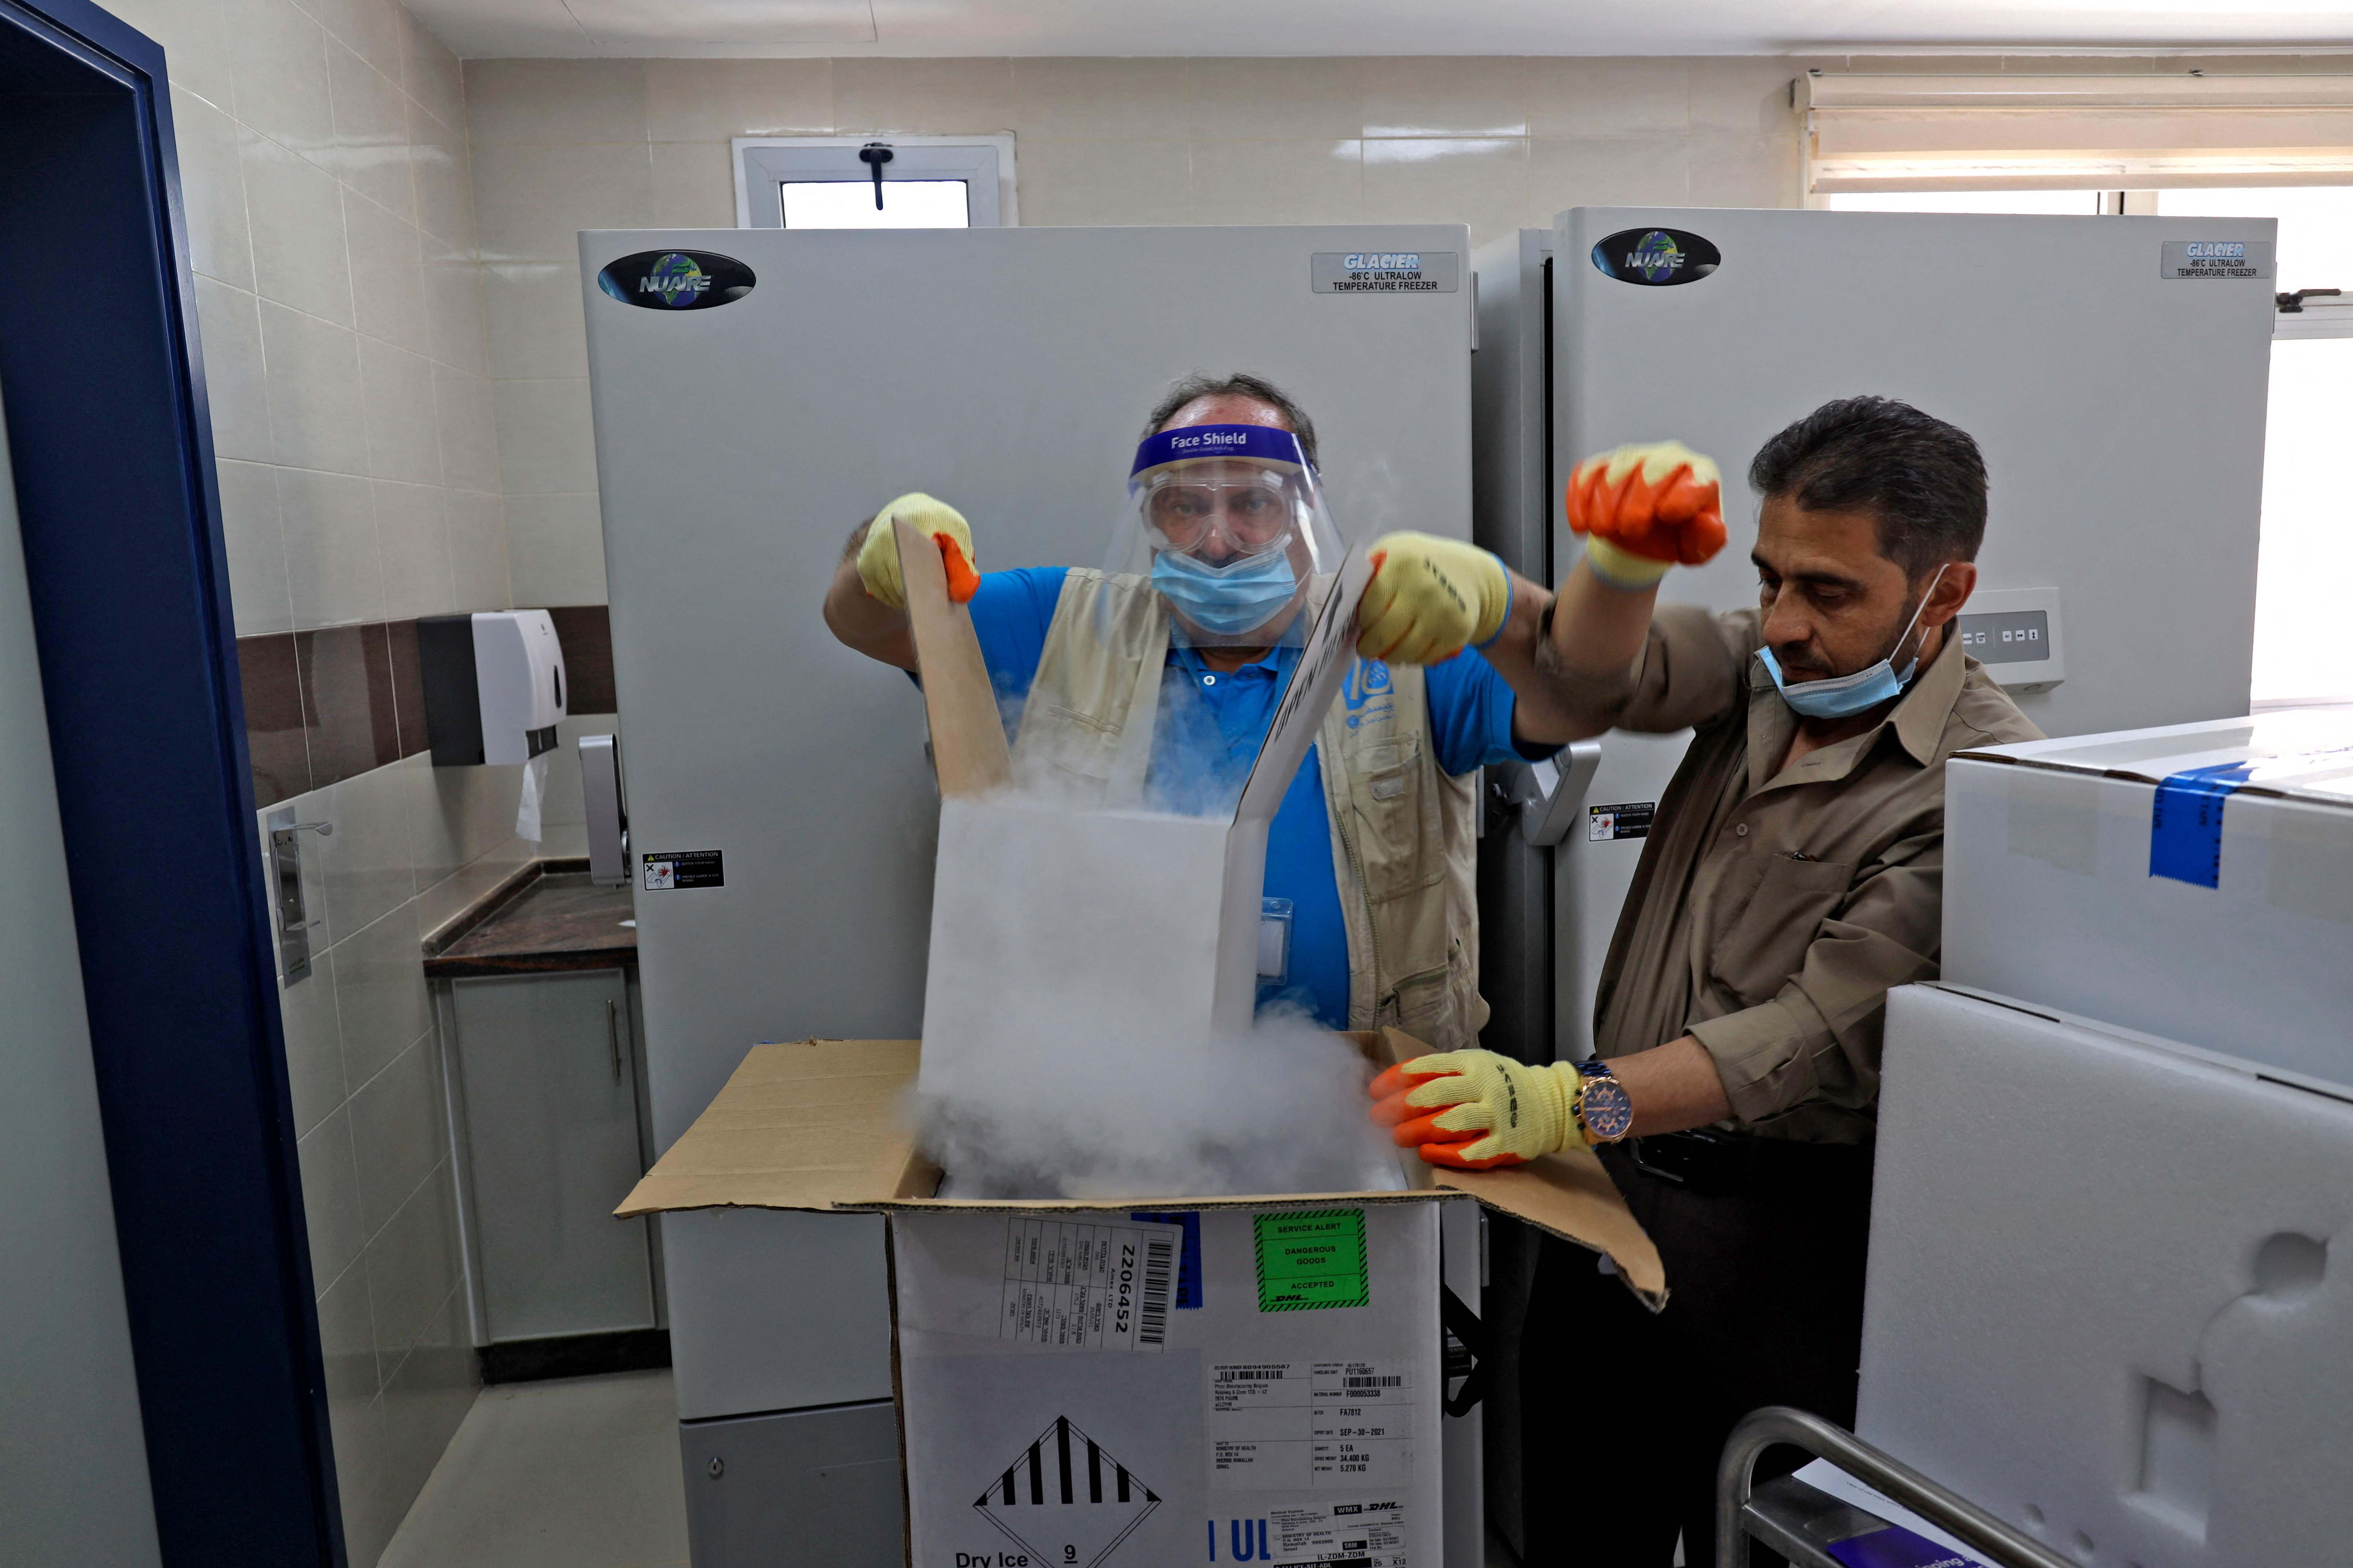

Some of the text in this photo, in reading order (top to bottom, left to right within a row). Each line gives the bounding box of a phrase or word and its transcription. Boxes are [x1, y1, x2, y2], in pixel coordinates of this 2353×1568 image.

[2187, 242, 2244, 257] GLACIER
[1344, 253, 1419, 269] GLACIER
[1375, 271, 1421, 280] ULTRALOW
[1333, 282, 1437, 290] TEMPERATURE FREEZER
[1171, 432, 1246, 449] Face Shield
[1285, 1246, 1336, 1255] DANGEROUS
[1116, 1245, 1134, 1333] Z206452
[1291, 1281, 1334, 1289] ACCEPTED
[1369, 1502, 1398, 1511] DHL
[1064, 1545, 1076, 1560] 9
[1318, 1551, 1365, 1561] IL-ZDM-ZDM
[956, 1552, 1028, 1568] Dry Ice
